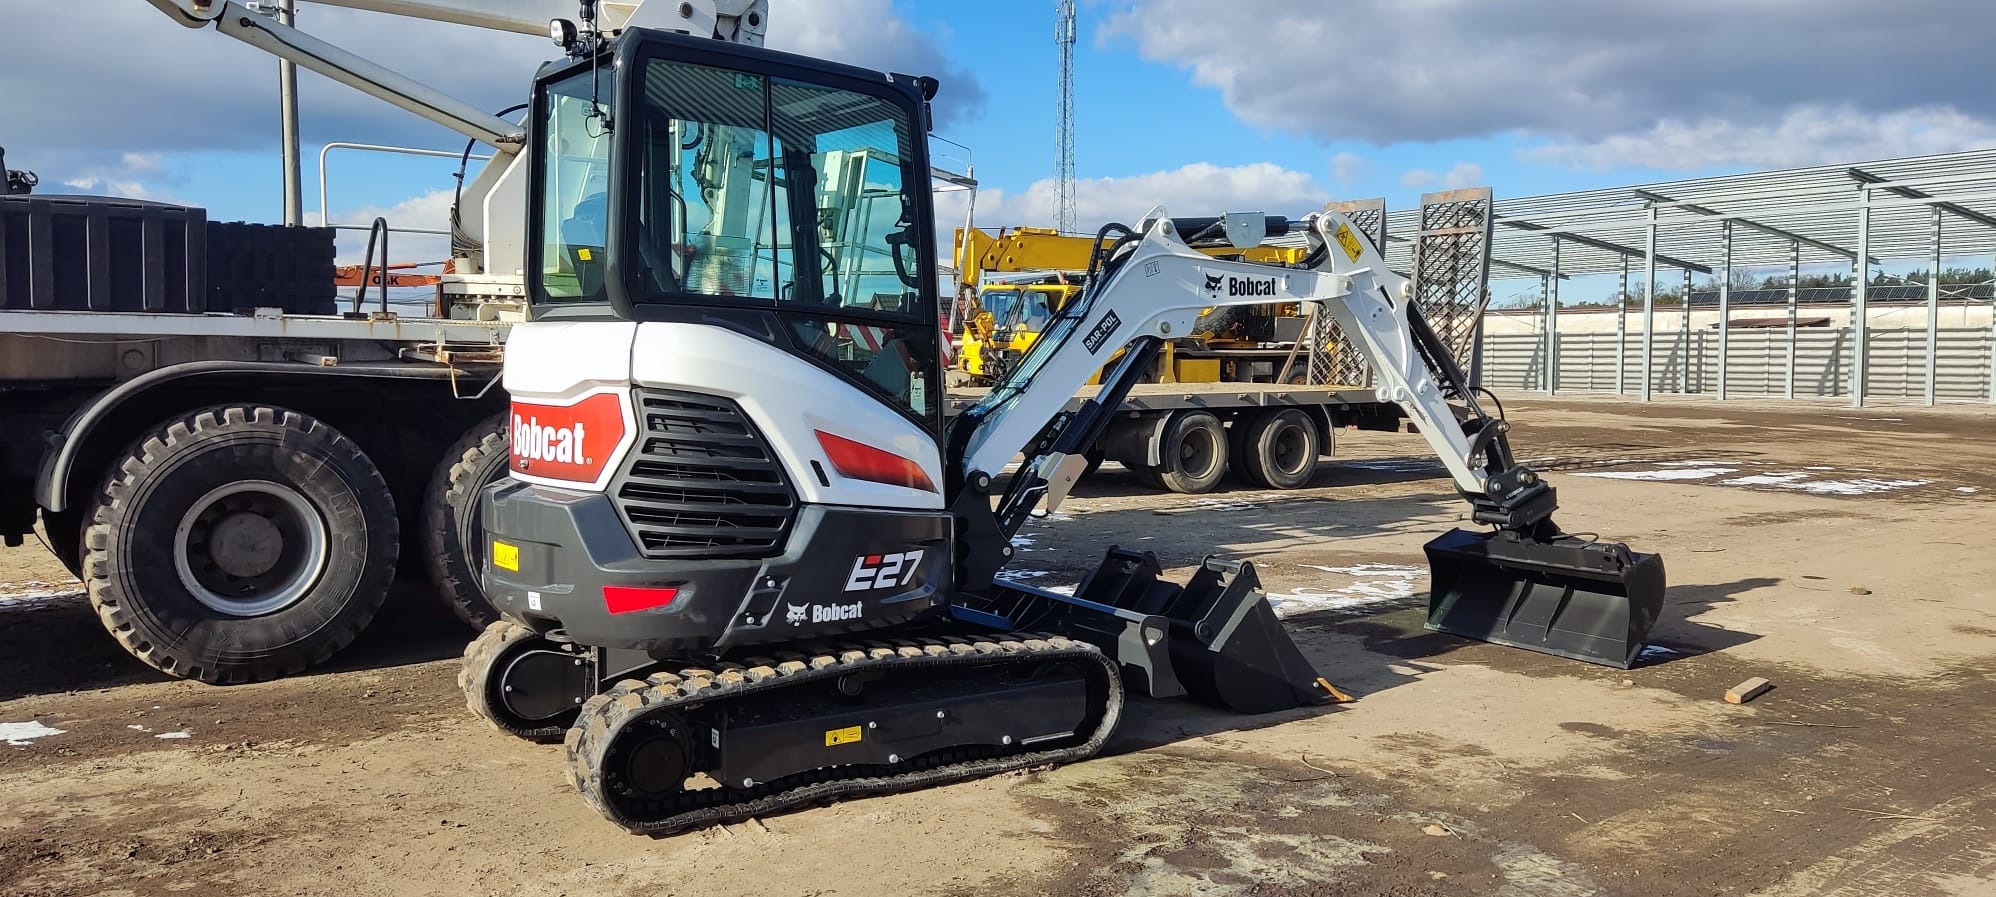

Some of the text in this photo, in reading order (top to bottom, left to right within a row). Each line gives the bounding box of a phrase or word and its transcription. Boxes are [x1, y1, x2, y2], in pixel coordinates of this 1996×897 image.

[372, 275, 399, 285] OK
[1229, 277, 1276, 296] Bobcat
[1085, 315, 1117, 349] SAR-POL
[513, 413, 585, 464] Bobcat
[843, 550, 924, 591] E27
[812, 601, 863, 623] Bobcat
